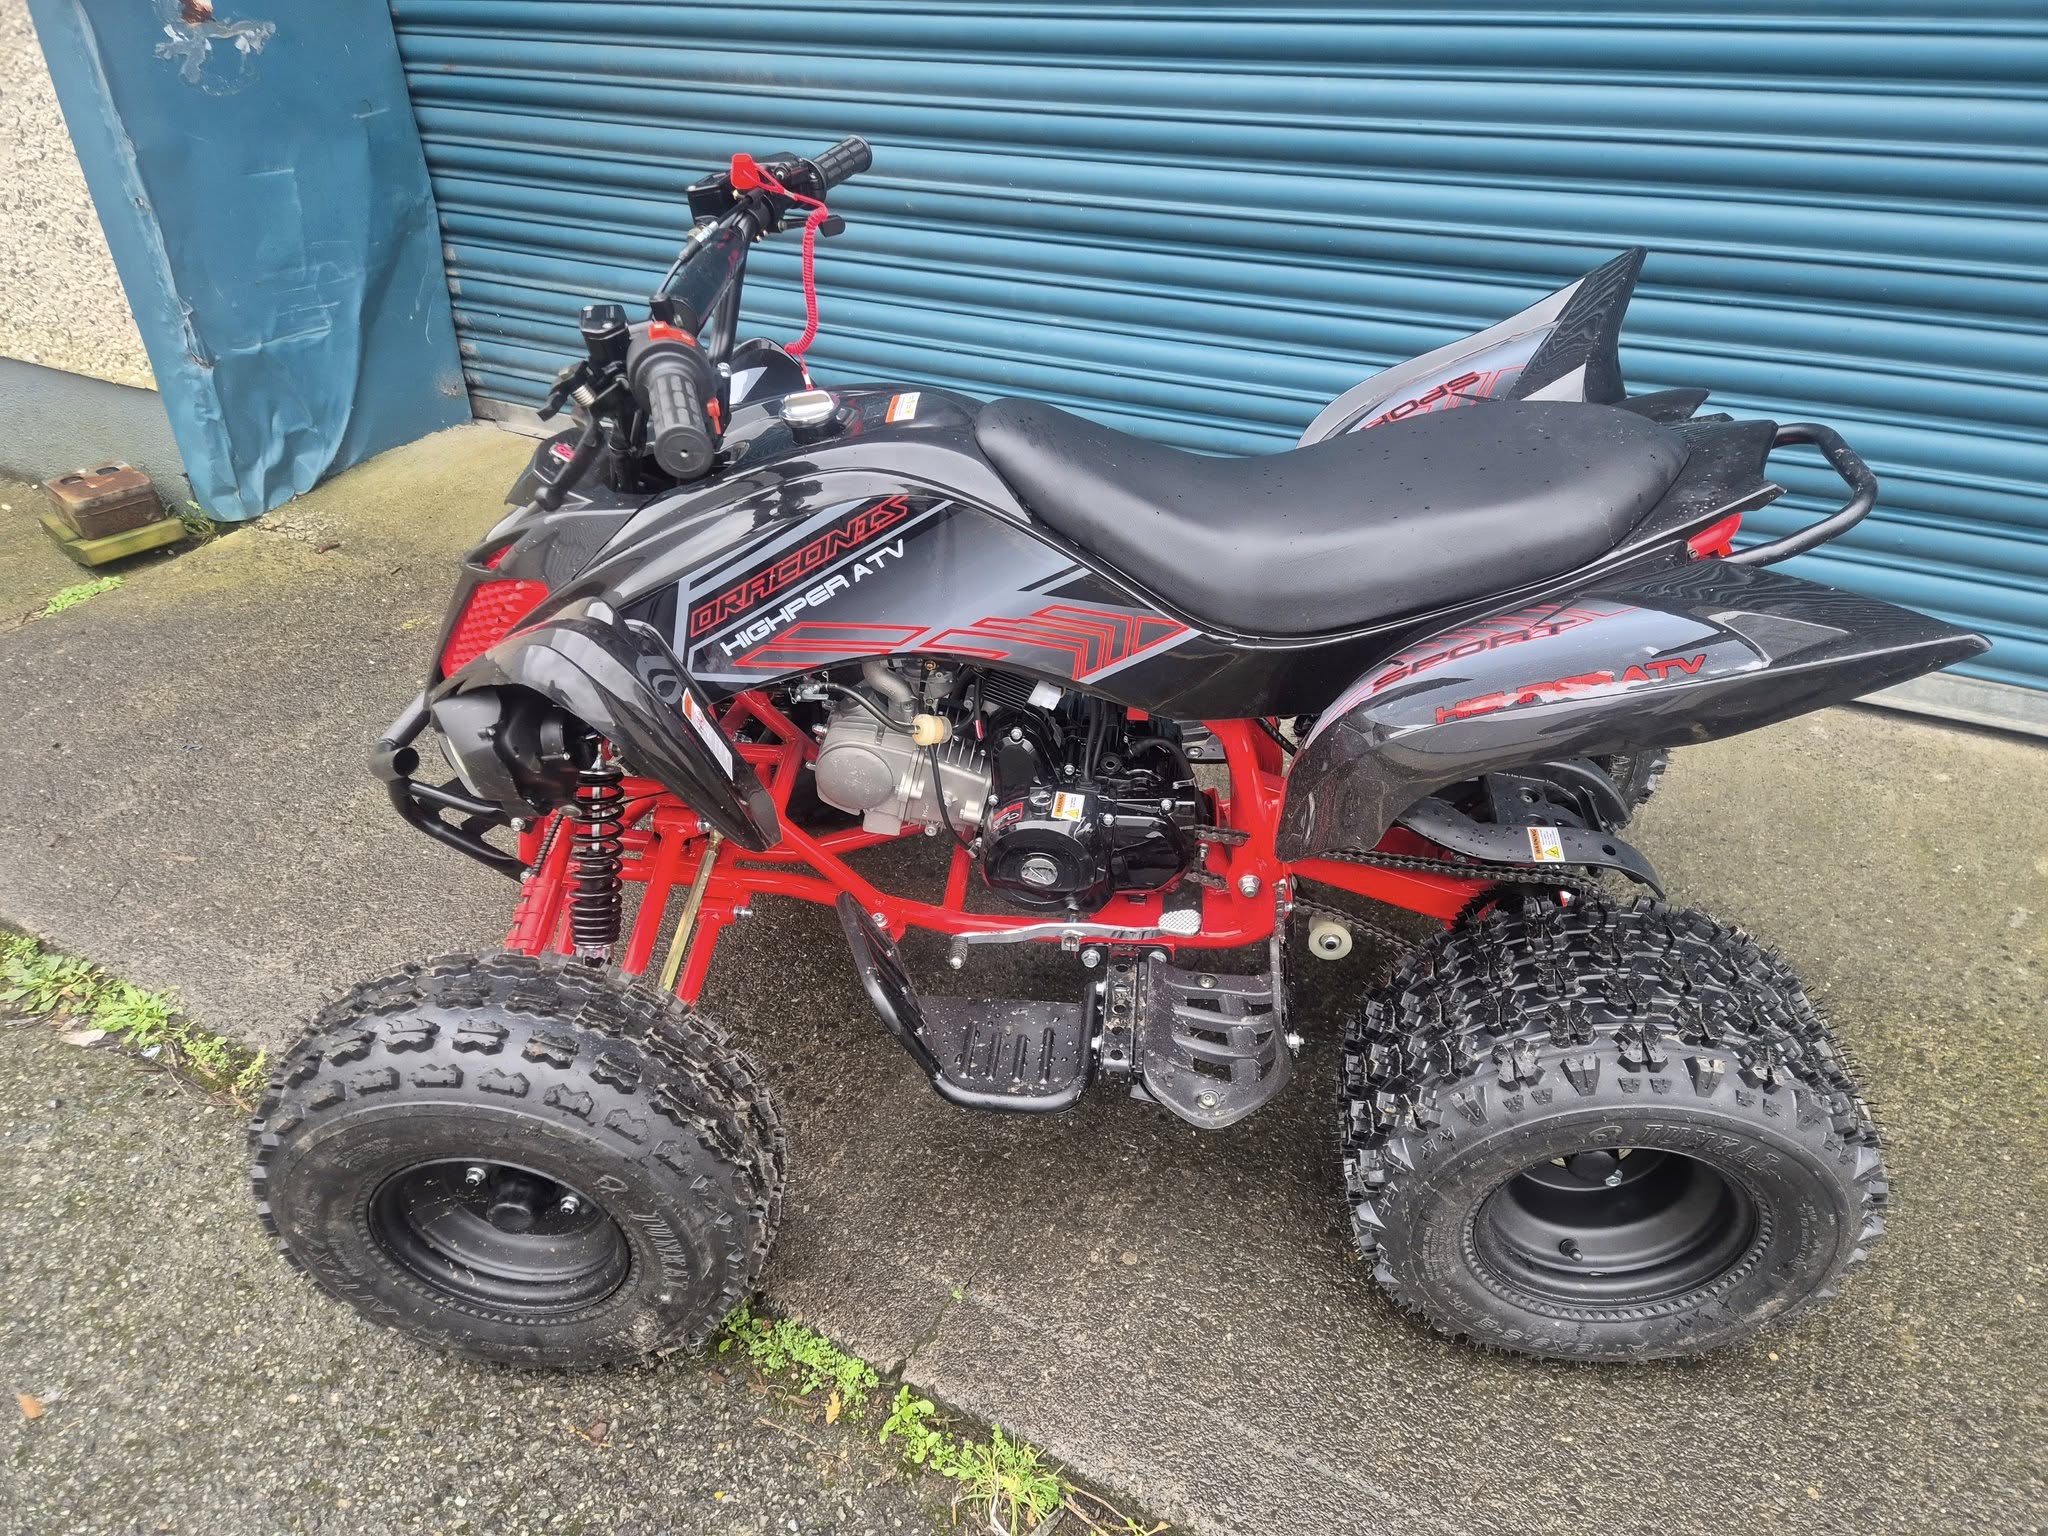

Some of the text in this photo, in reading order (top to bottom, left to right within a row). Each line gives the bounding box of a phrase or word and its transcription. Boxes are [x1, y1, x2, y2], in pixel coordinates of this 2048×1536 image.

[689, 495, 909, 638] DRACONIS
[720, 539, 904, 657] HIGHPER ATV
[1373, 618, 1577, 693] SPORT
[1622, 653, 1707, 682] ATV
